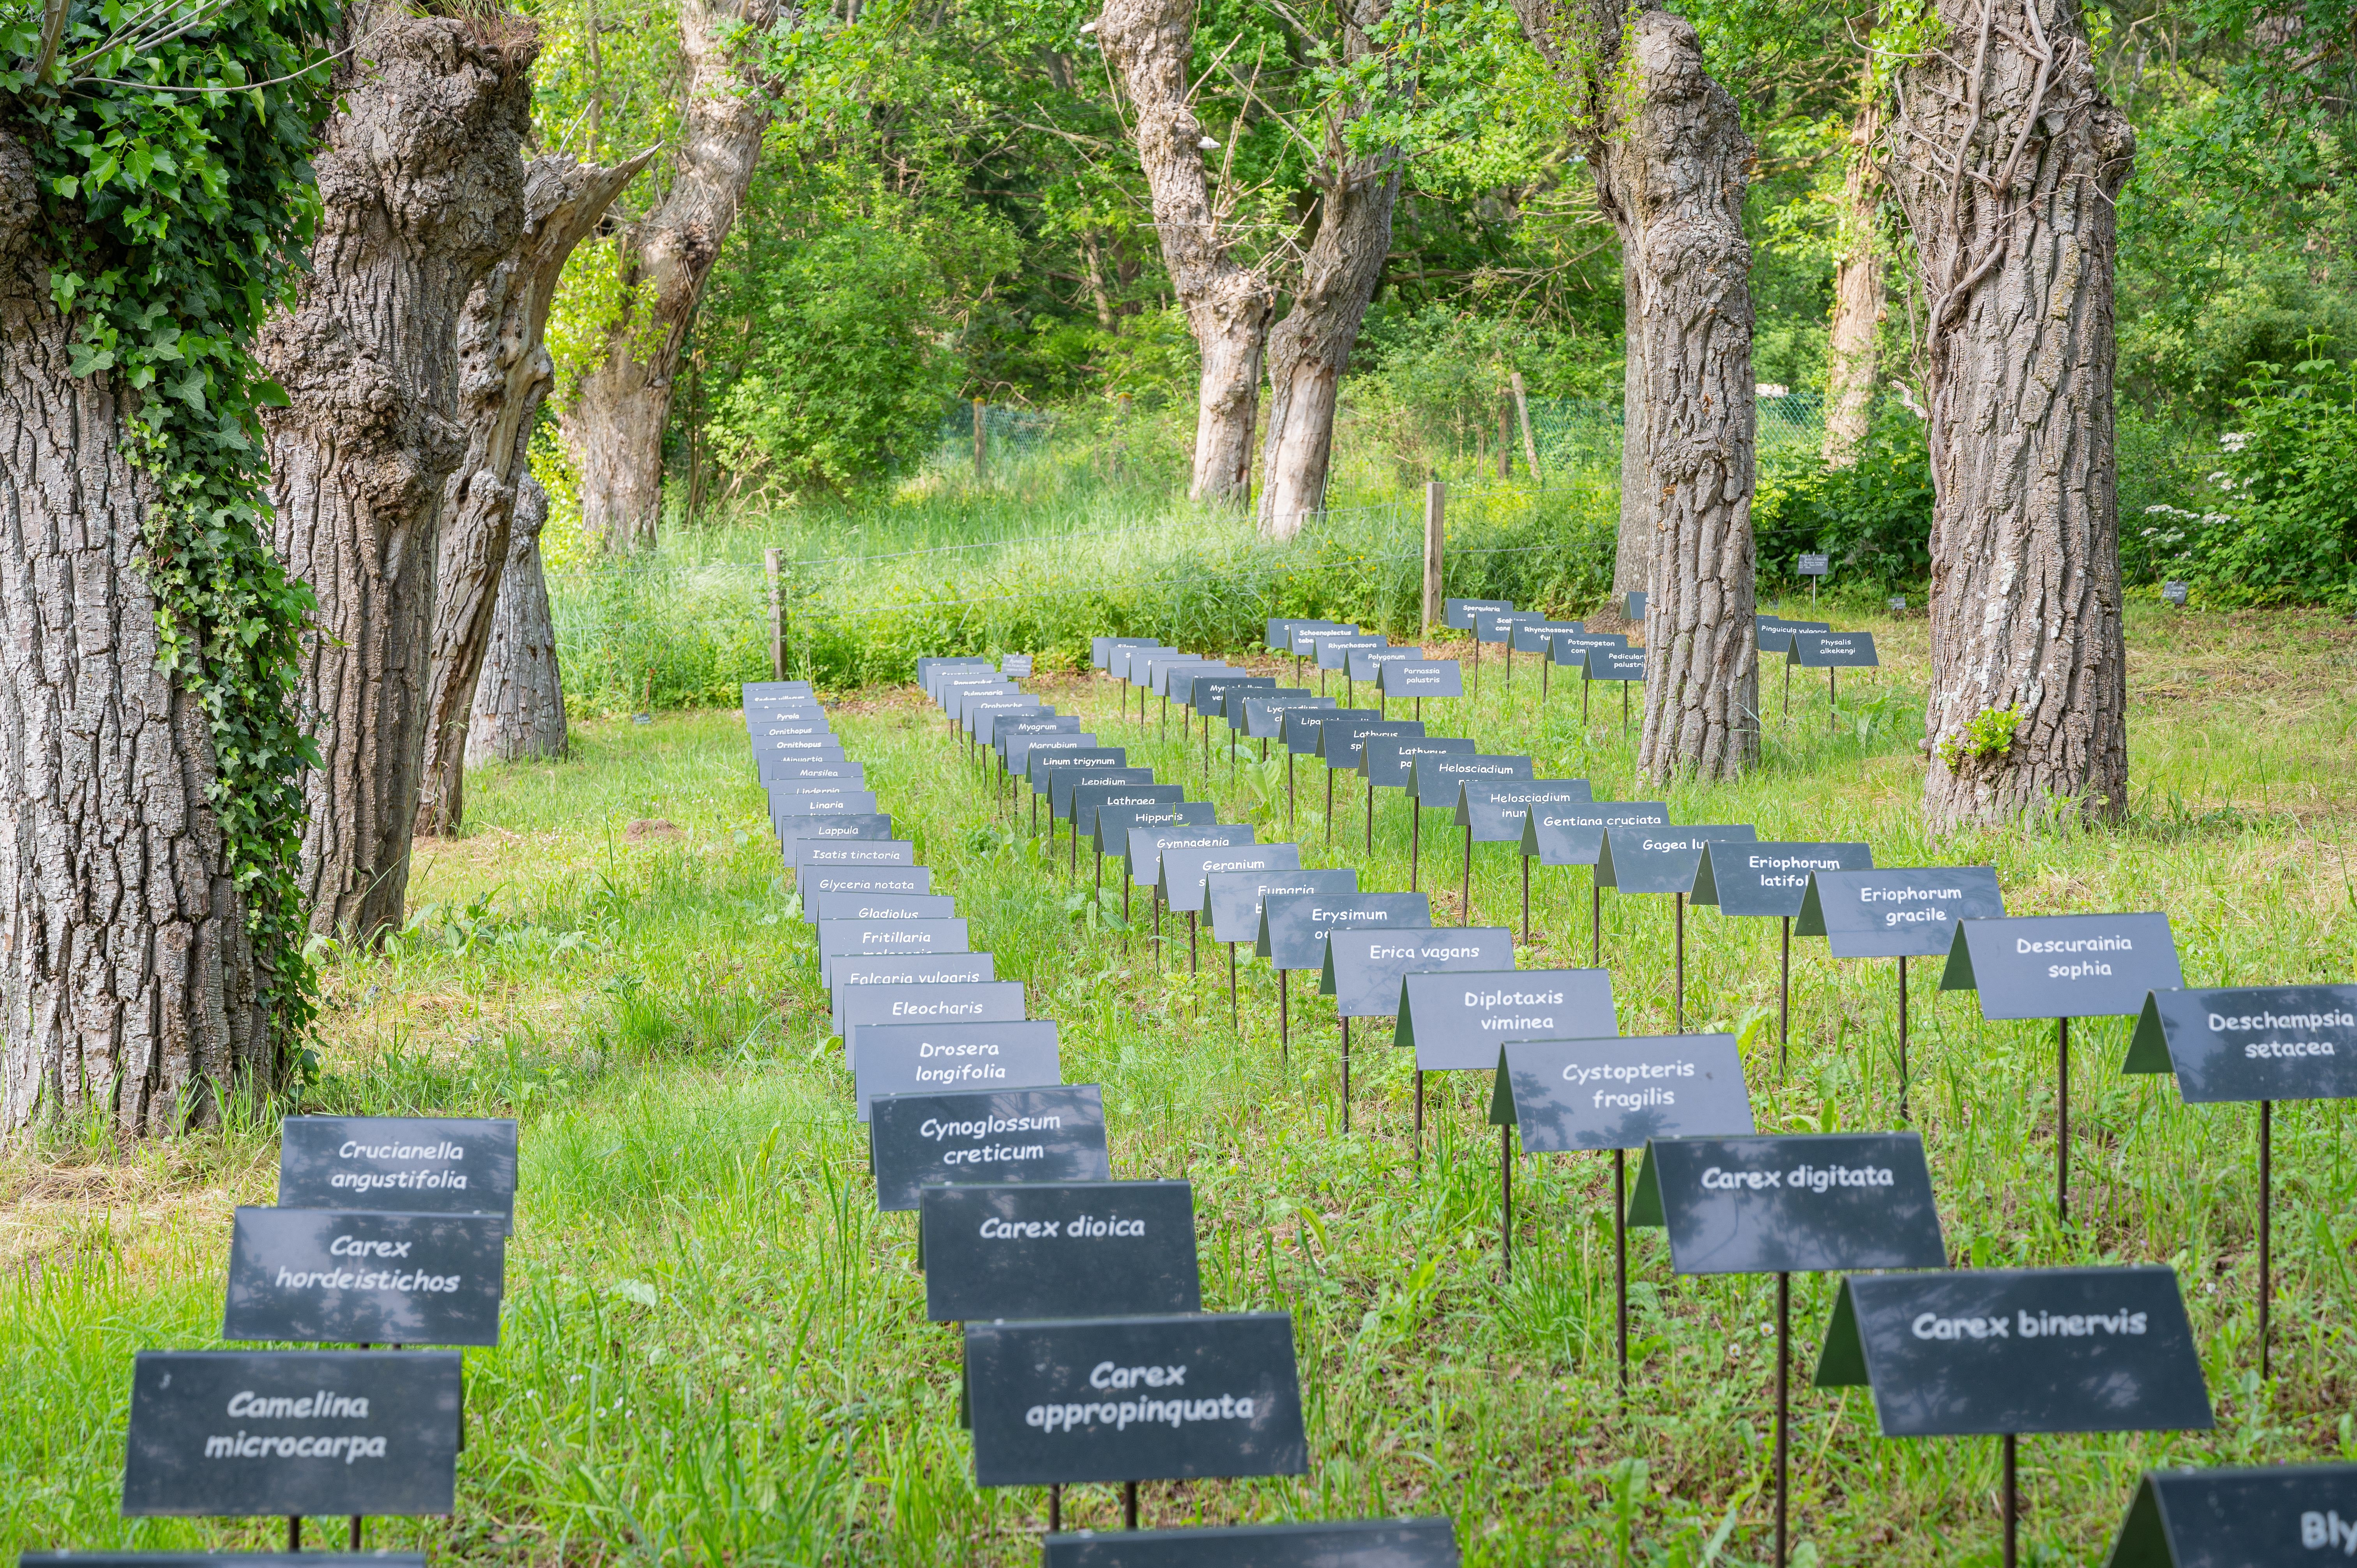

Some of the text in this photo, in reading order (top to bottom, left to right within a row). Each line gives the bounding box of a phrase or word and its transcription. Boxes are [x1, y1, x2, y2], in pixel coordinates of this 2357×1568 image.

[1762, 625, 1797, 634] Pinguicula
[1568, 639, 1615, 648] Potamogeton
[1406, 676, 1440, 685] palustris
[777, 713, 799, 721] Pyrola
[1073, 757, 1115, 767] trigynum
[1439, 763, 1513, 774] Helosciadium
[1081, 777, 1125, 786] Lepidium
[810, 801, 843, 809] Linaria
[1107, 796, 1155, 805] Lathraea
[1491, 793, 1570, 803] Helosciadium
[1136, 812, 1183, 824] Hippuris
[1543, 815, 1661, 826] Gentiana cruciata
[818, 826, 859, 837] Lappula
[1157, 837, 1229, 849] Gymnadenia
[1643, 839, 1687, 853] Gagea
[813, 850, 900, 860] Isatis tinctoria
[1202, 859, 1265, 871] Geranium
[1749, 856, 1840, 872] Eriophorum
[820, 879, 914, 892] Glyceria notata
[1861, 886, 1962, 904] Eriophorum
[859, 908, 919, 919] Gladiolus
[1312, 908, 1387, 923] Erysimum
[1886, 907, 1947, 926] gracile
[862, 931, 931, 944] Fritillaria
[2017, 935, 2133, 954] Descurainia
[1370, 945, 1480, 961] Erica vagans
[850, 972, 912, 984] Falcaria
[2048, 961, 2112, 980] sophia
[1465, 990, 1563, 1010] Diplotaxis
[892, 1001, 983, 1015] Eleocharis
[1481, 1015, 1554, 1029] viminea
[2209, 1009, 2355, 1032] Deschampsia
[920, 1043, 999, 1058] Drosera
[2246, 1041, 2335, 1058] setacea
[916, 1063, 1005, 1084] longifolia
[1562, 1060, 1694, 1085] Cystopteris
[1592, 1087, 1675, 1111] fragilis
[921, 1115, 1061, 1141] Cynoglossum
[339, 1141, 463, 1159] Crucianella
[944, 1143, 1043, 1164] creticum
[331, 1169, 466, 1192] angustifolia
[1702, 1165, 1894, 1192] Carex digitata
[980, 1215, 1144, 1238] Carex dioica
[330, 1236, 411, 1257] Carex
[276, 1266, 459, 1291] hordeistichos
[1913, 1309, 2146, 1338] Carex binervis
[1091, 1363, 1184, 1388] Carex
[229, 1391, 368, 1417] Camelina
[1027, 1394, 1255, 1432] appropinquata
[205, 1431, 386, 1463] microcarpa
